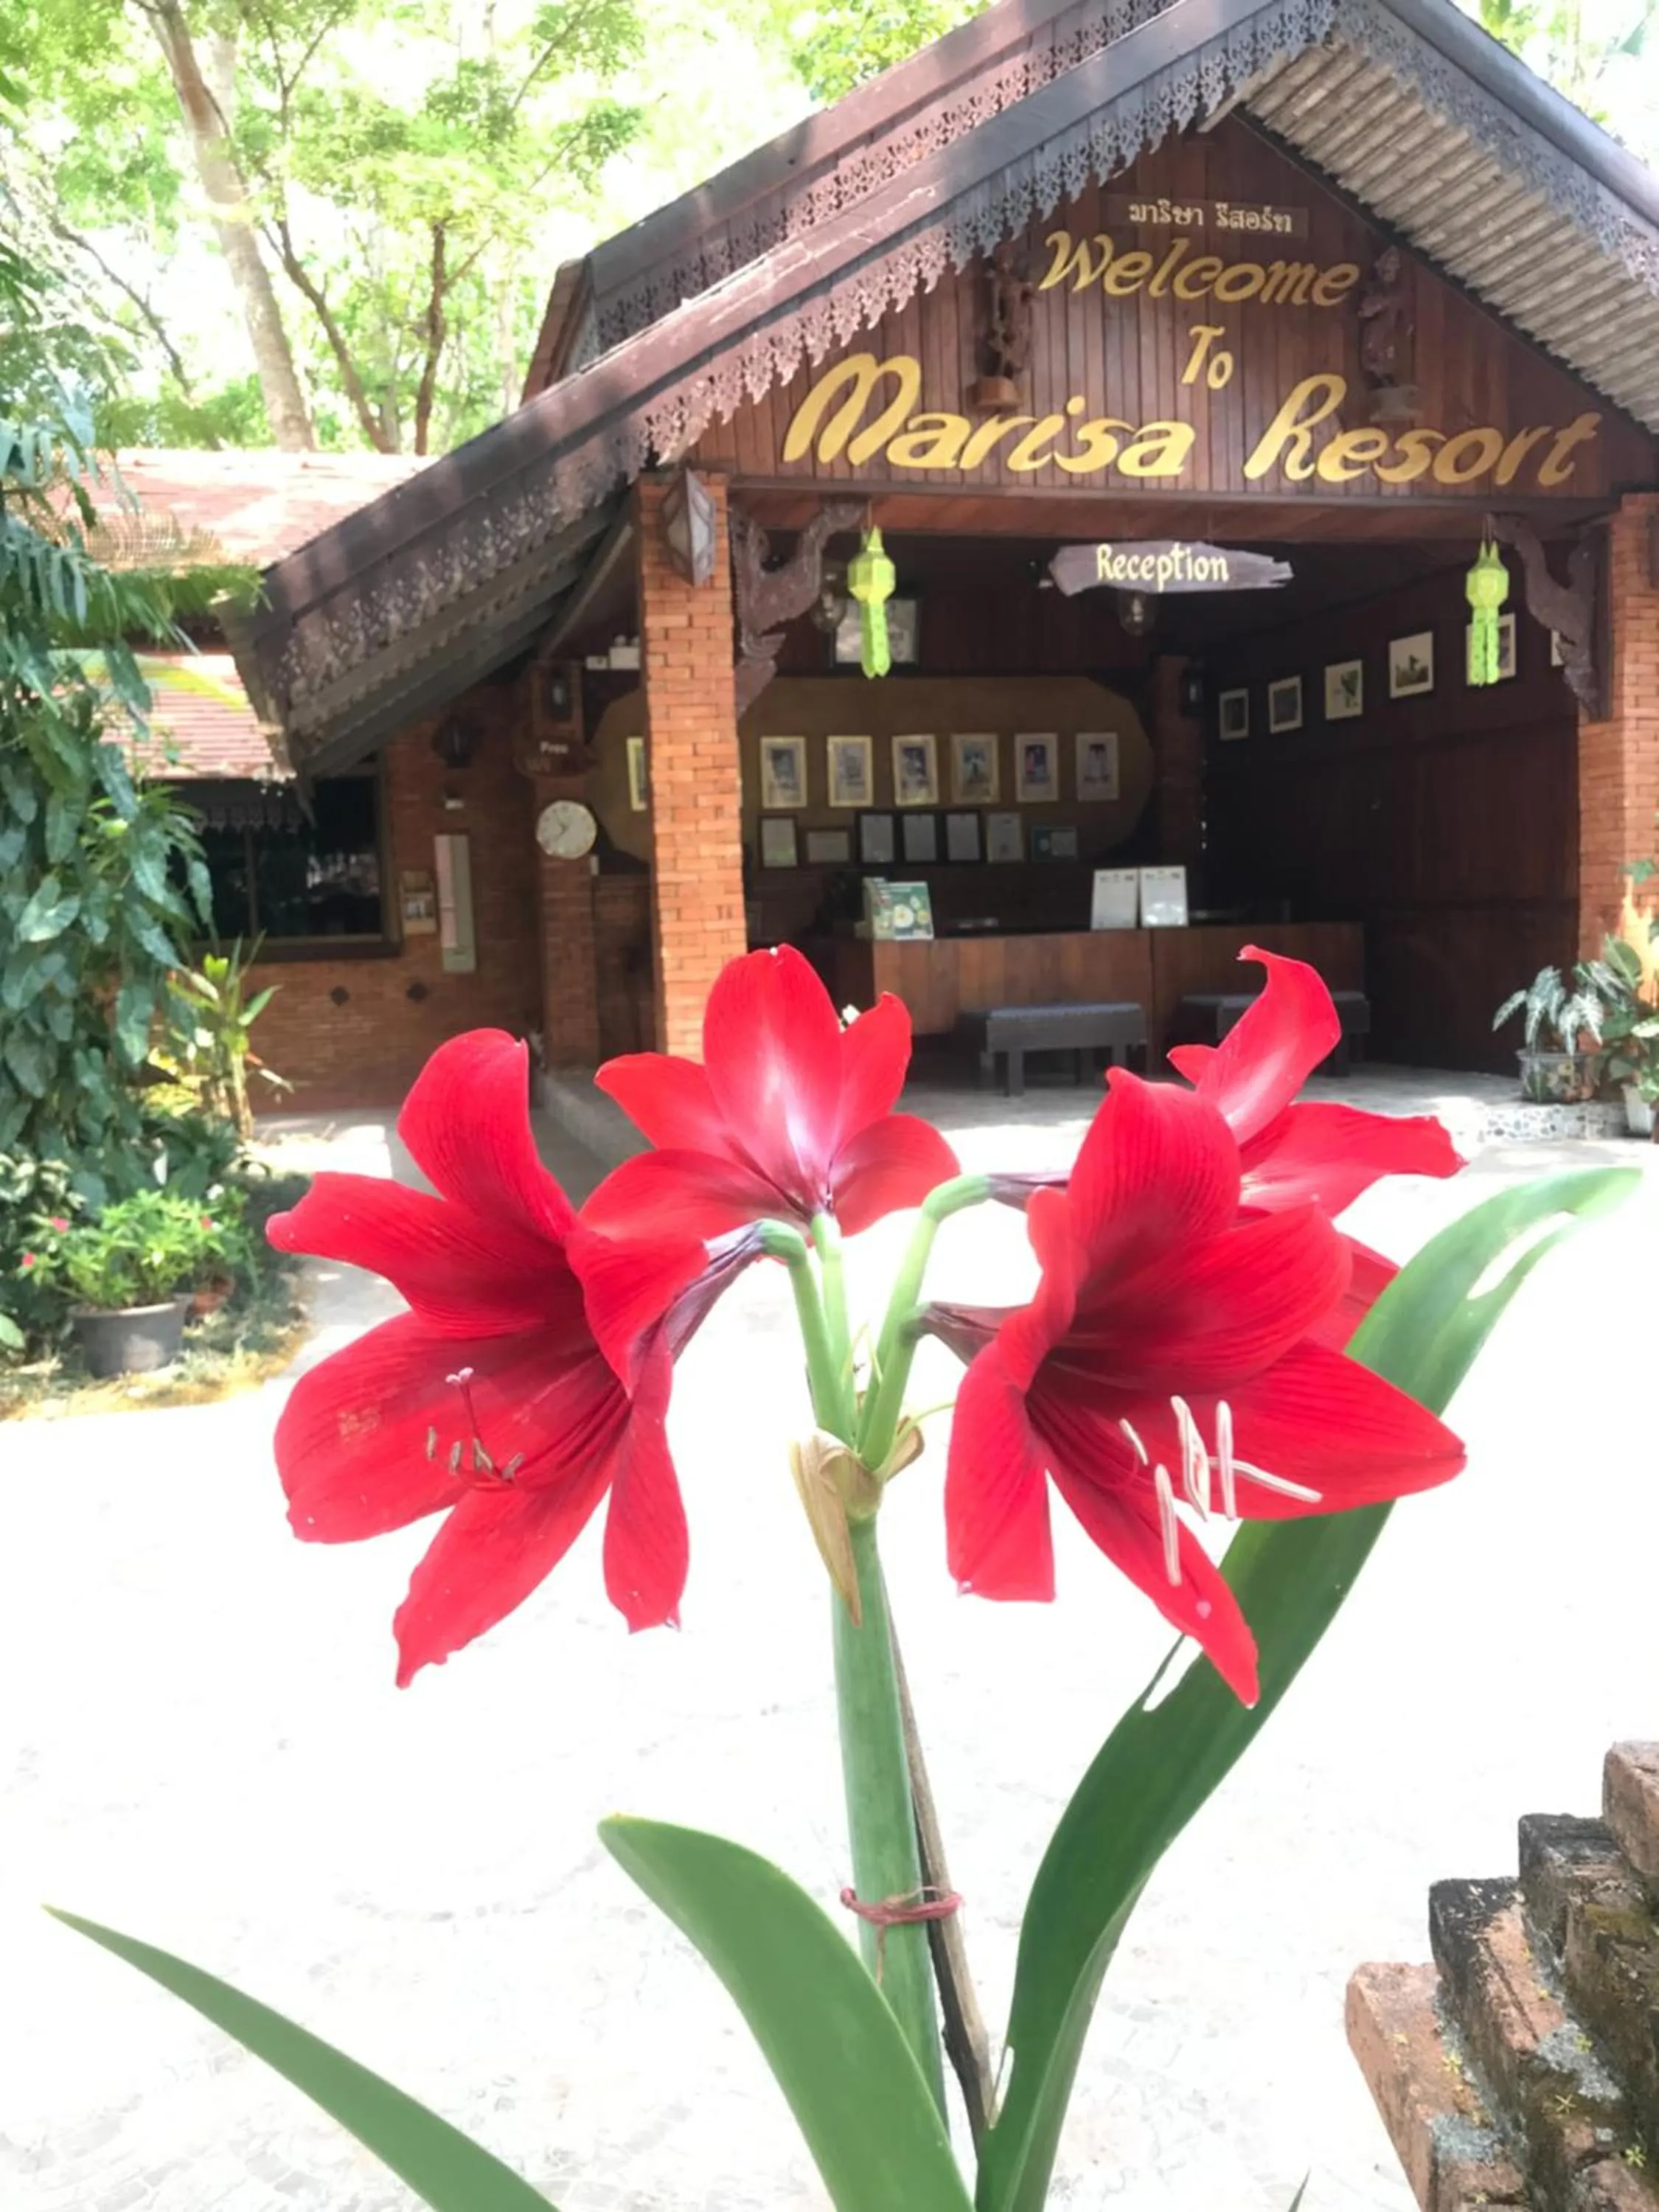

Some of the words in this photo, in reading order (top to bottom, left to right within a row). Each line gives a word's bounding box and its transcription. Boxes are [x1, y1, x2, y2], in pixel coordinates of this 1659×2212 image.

[1037, 230, 1360, 307] Welcome
[1181, 325, 1234, 389] To
[783, 352, 1197, 476] Marisa
[1242, 373, 1603, 487] Resort
[1096, 542, 1229, 593] Reception
